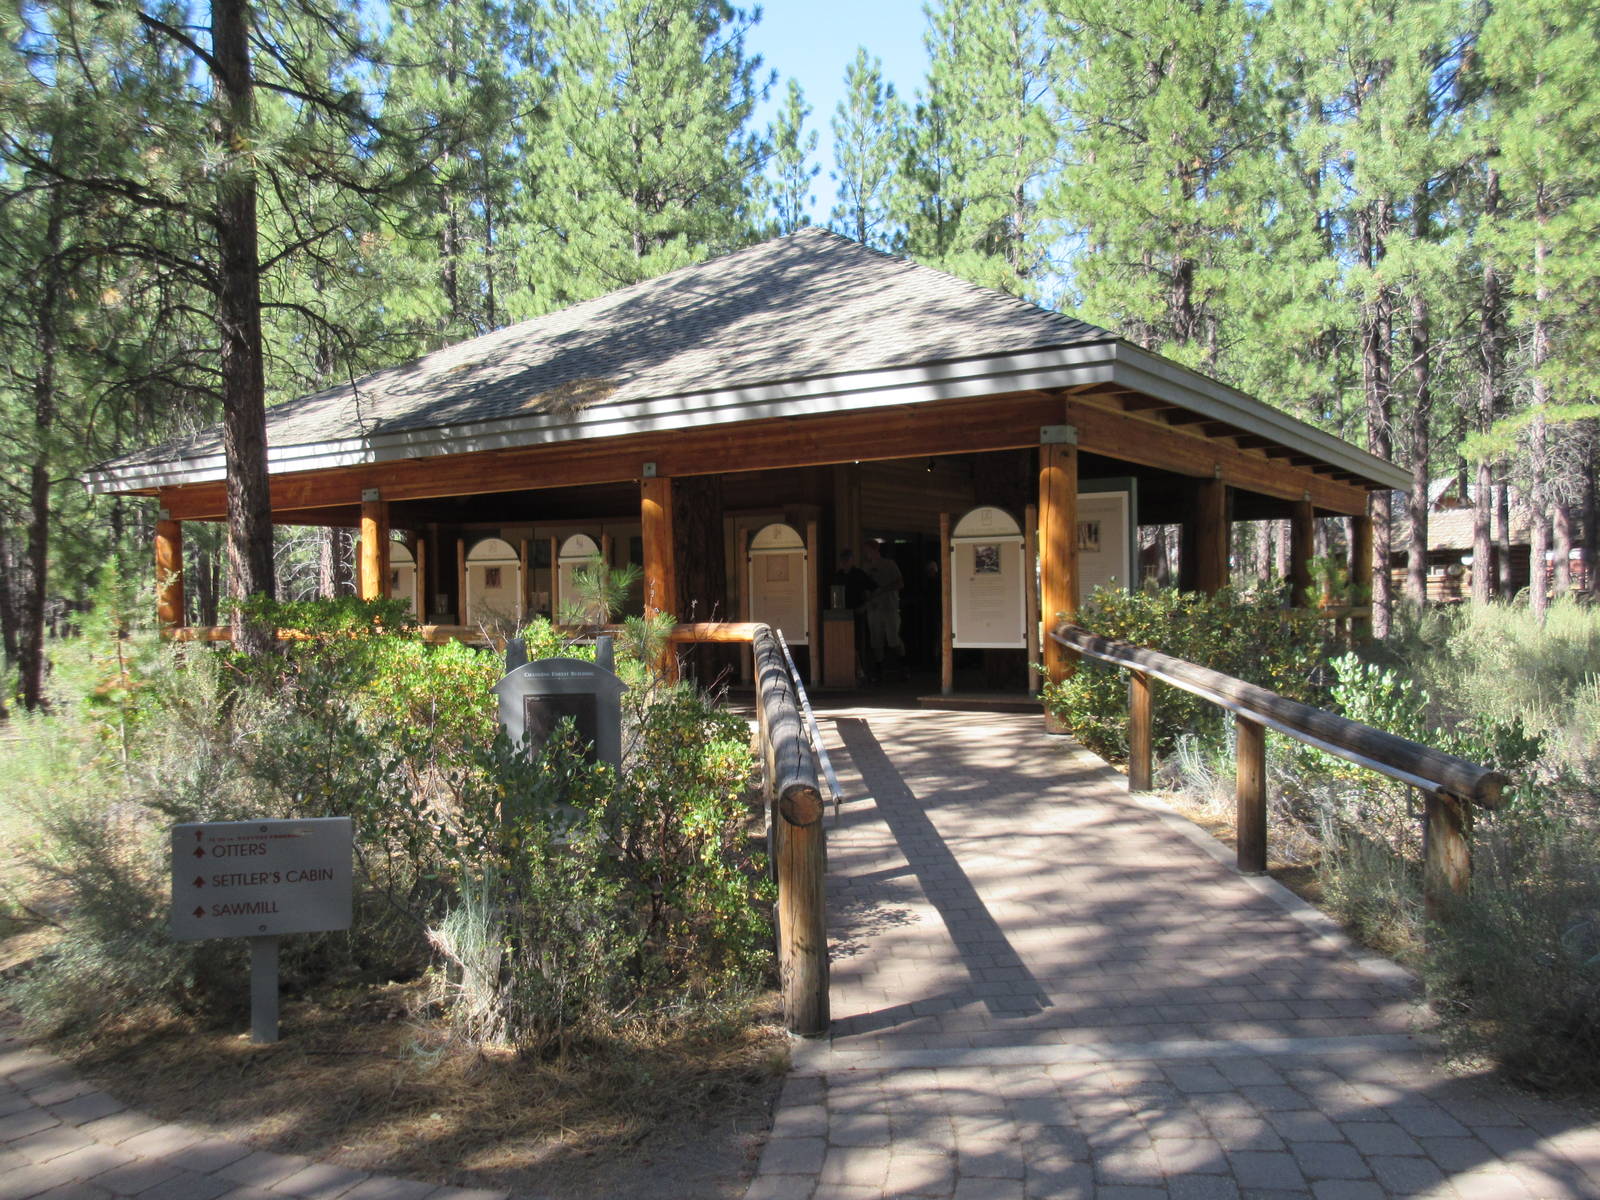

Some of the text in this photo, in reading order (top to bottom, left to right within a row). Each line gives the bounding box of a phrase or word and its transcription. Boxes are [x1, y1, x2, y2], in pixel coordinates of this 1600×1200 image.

[212, 842, 267, 858] OTTERS
[211, 868, 334, 888] SETTLER'S CABIN
[211, 900, 280, 917] SAWMILL
